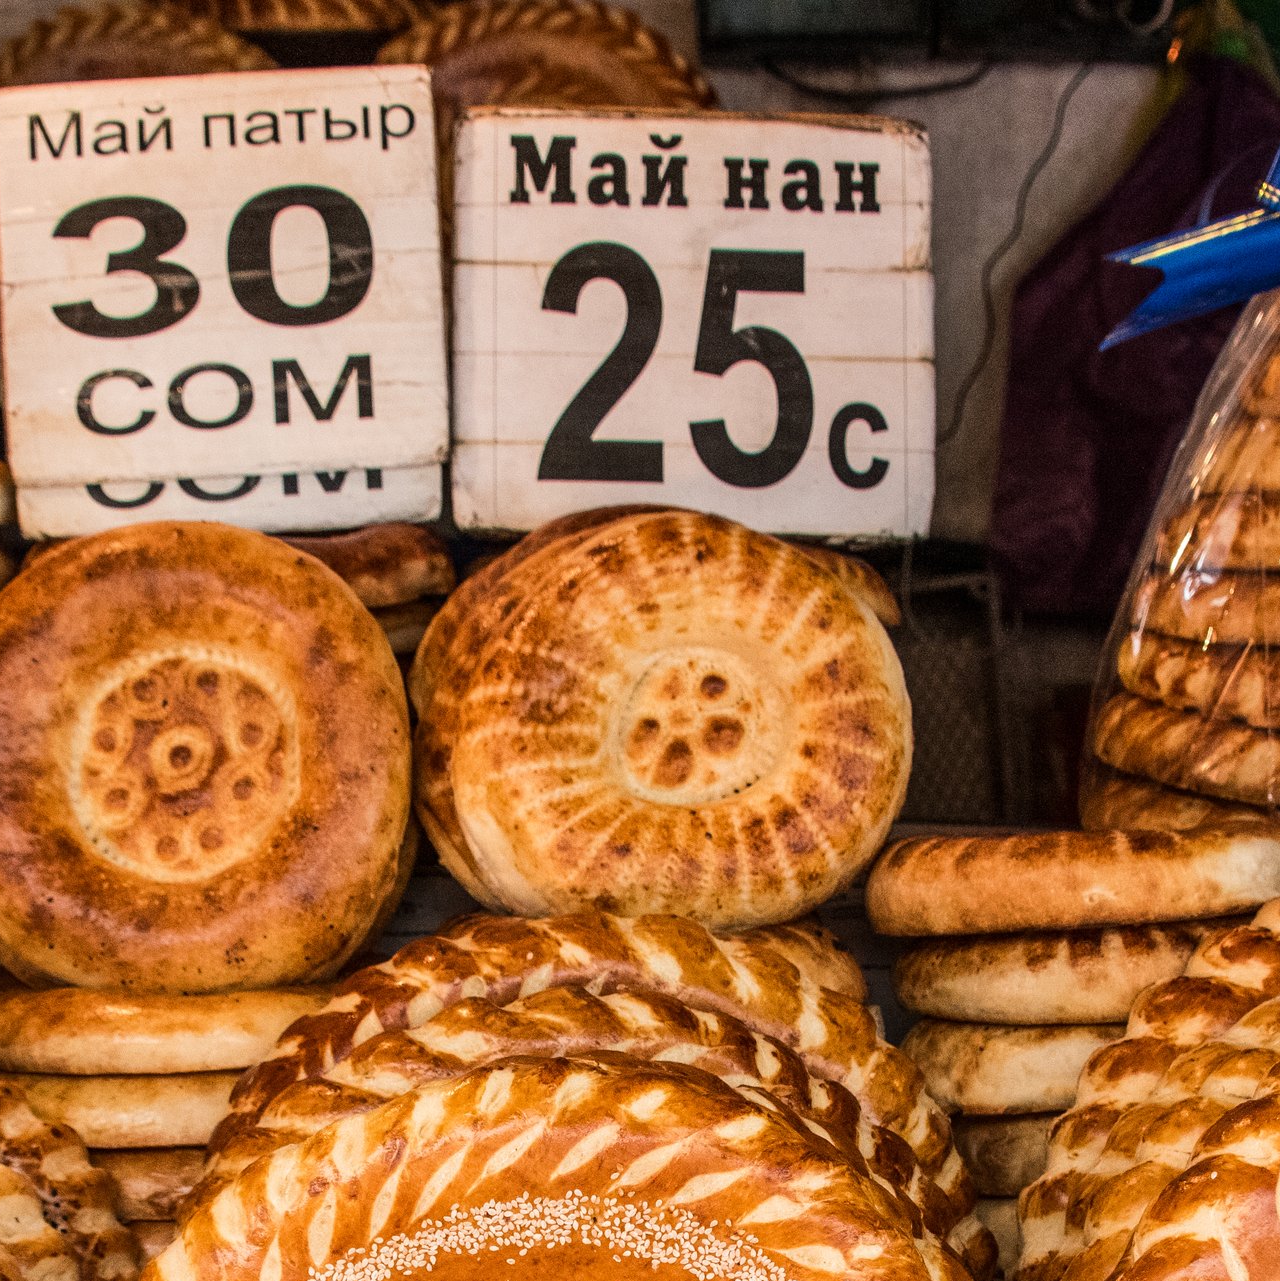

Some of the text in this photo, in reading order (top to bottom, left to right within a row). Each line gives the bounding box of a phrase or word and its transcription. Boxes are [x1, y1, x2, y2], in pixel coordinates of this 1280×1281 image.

[28, 102, 417, 161] Май патыр
[508, 132, 882, 215] Май нан
[50, 183, 375, 340] 30
[536, 240, 815, 489] 25
